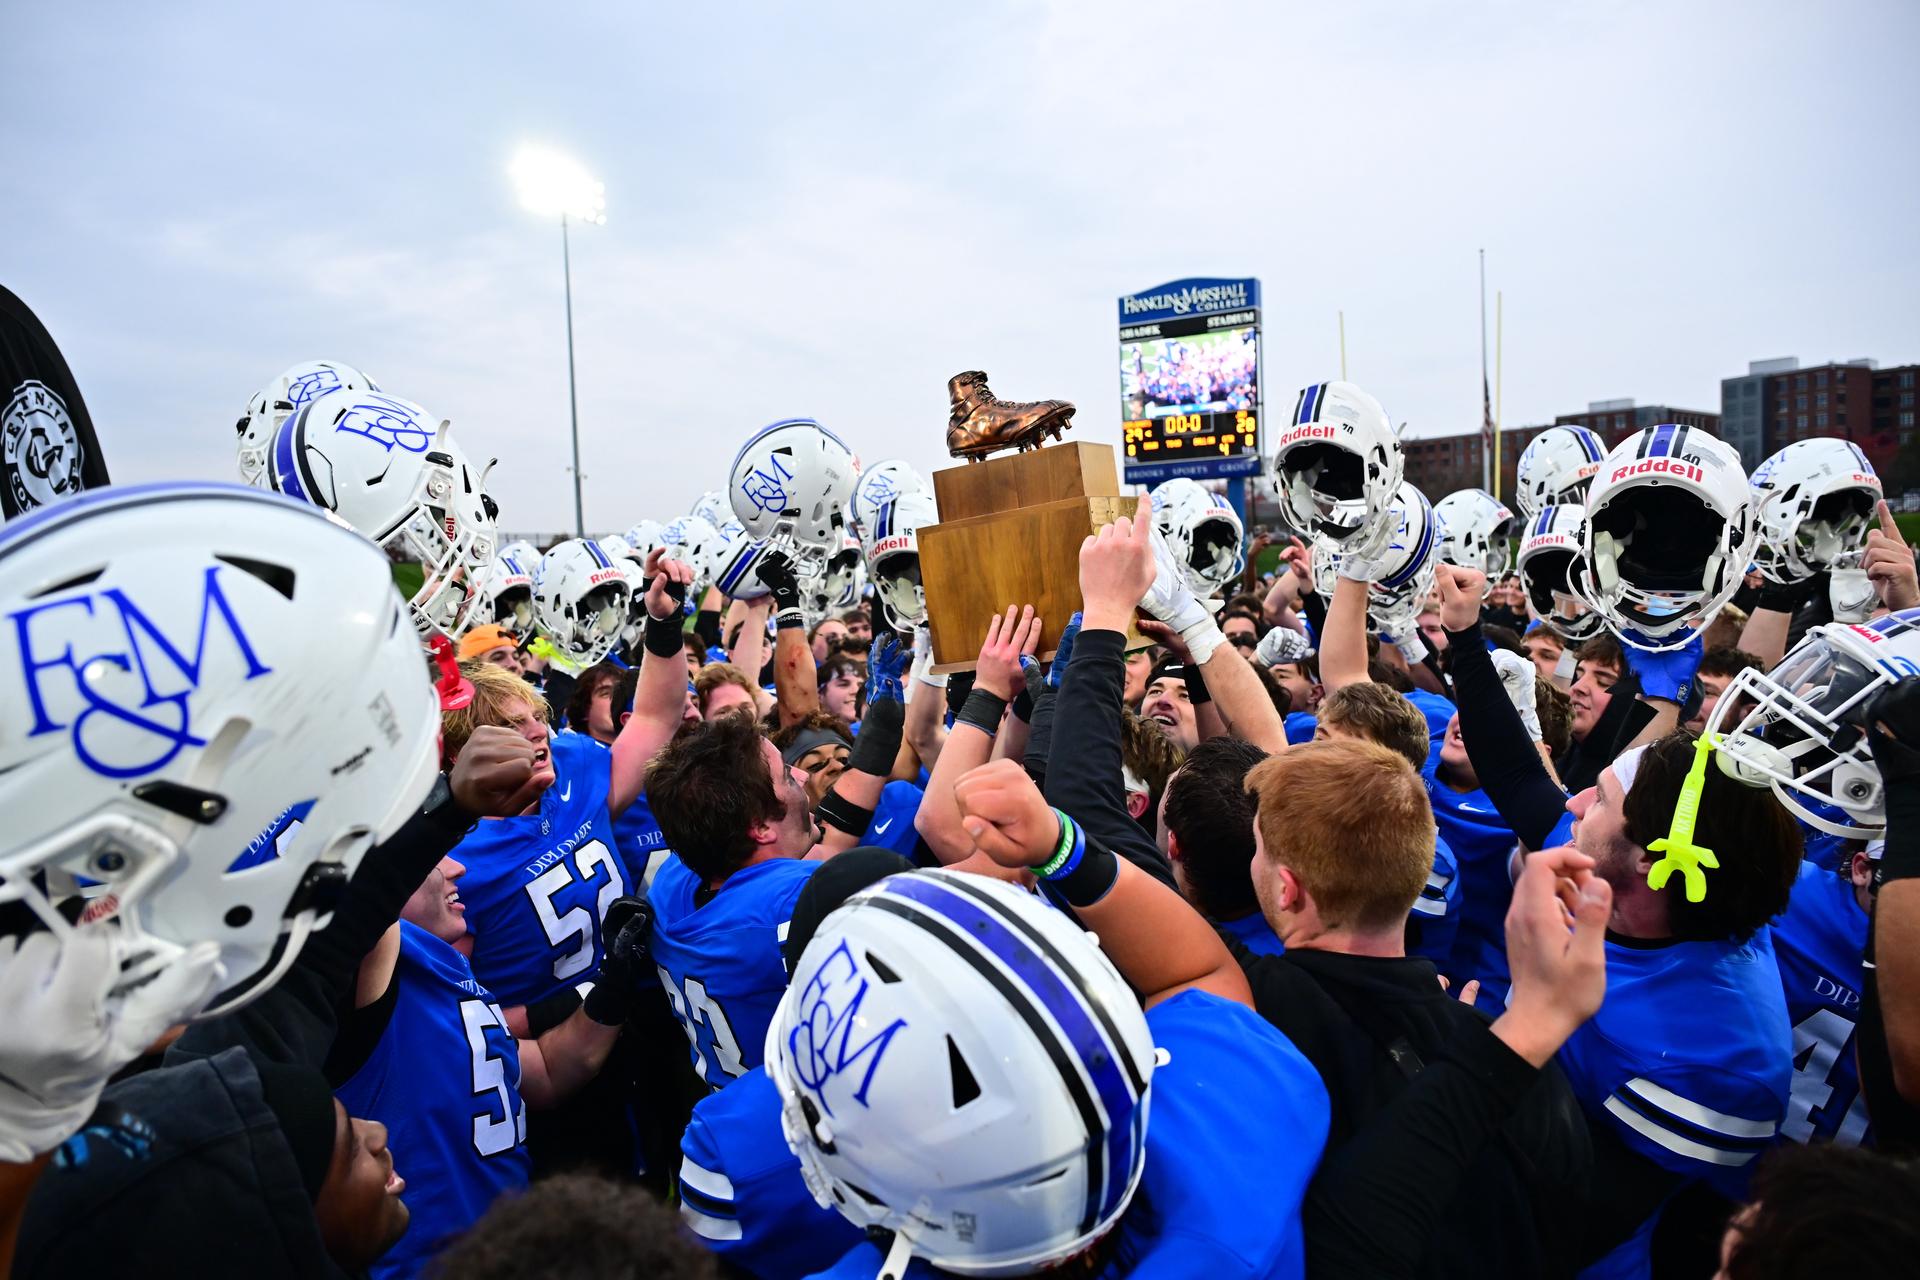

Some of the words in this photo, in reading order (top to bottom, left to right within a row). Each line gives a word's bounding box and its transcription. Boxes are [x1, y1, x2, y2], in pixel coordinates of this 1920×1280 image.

[1181, 282, 1248, 306] MARSHALL
[1196, 298, 1247, 313] COLLEGE
[1206, 311, 1255, 328] STADIUM
[1280, 425, 1334, 447] Riddell
[1611, 459, 1704, 484] Riddell
